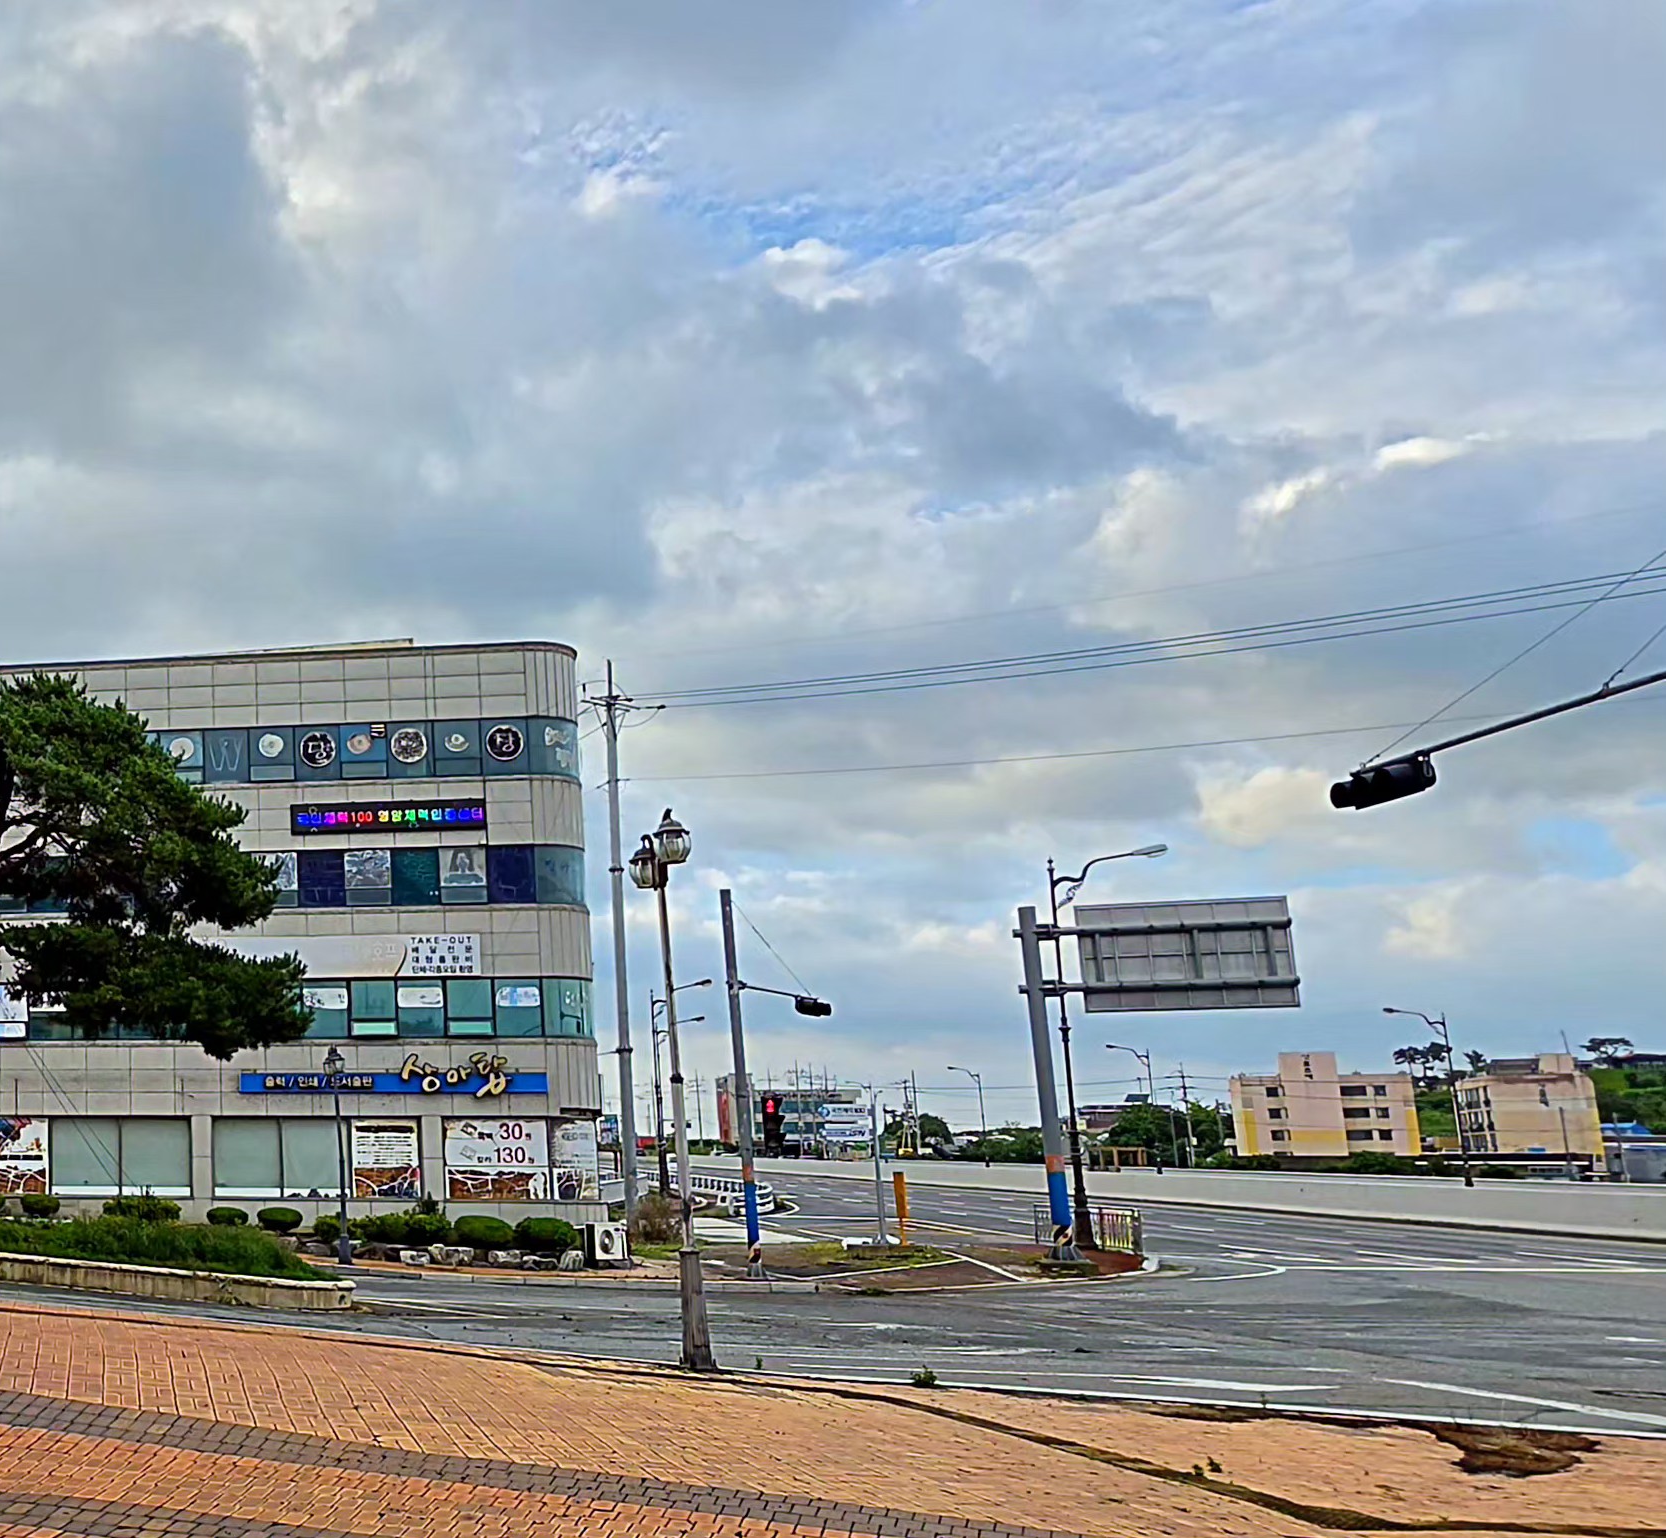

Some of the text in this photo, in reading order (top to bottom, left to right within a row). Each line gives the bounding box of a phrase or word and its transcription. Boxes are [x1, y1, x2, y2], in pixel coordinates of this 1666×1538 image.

[410, 936, 472, 945] TAKE-OUT
[265, 1075, 286, 1087] 출력
[297, 1075, 319, 1087] 인쇄
